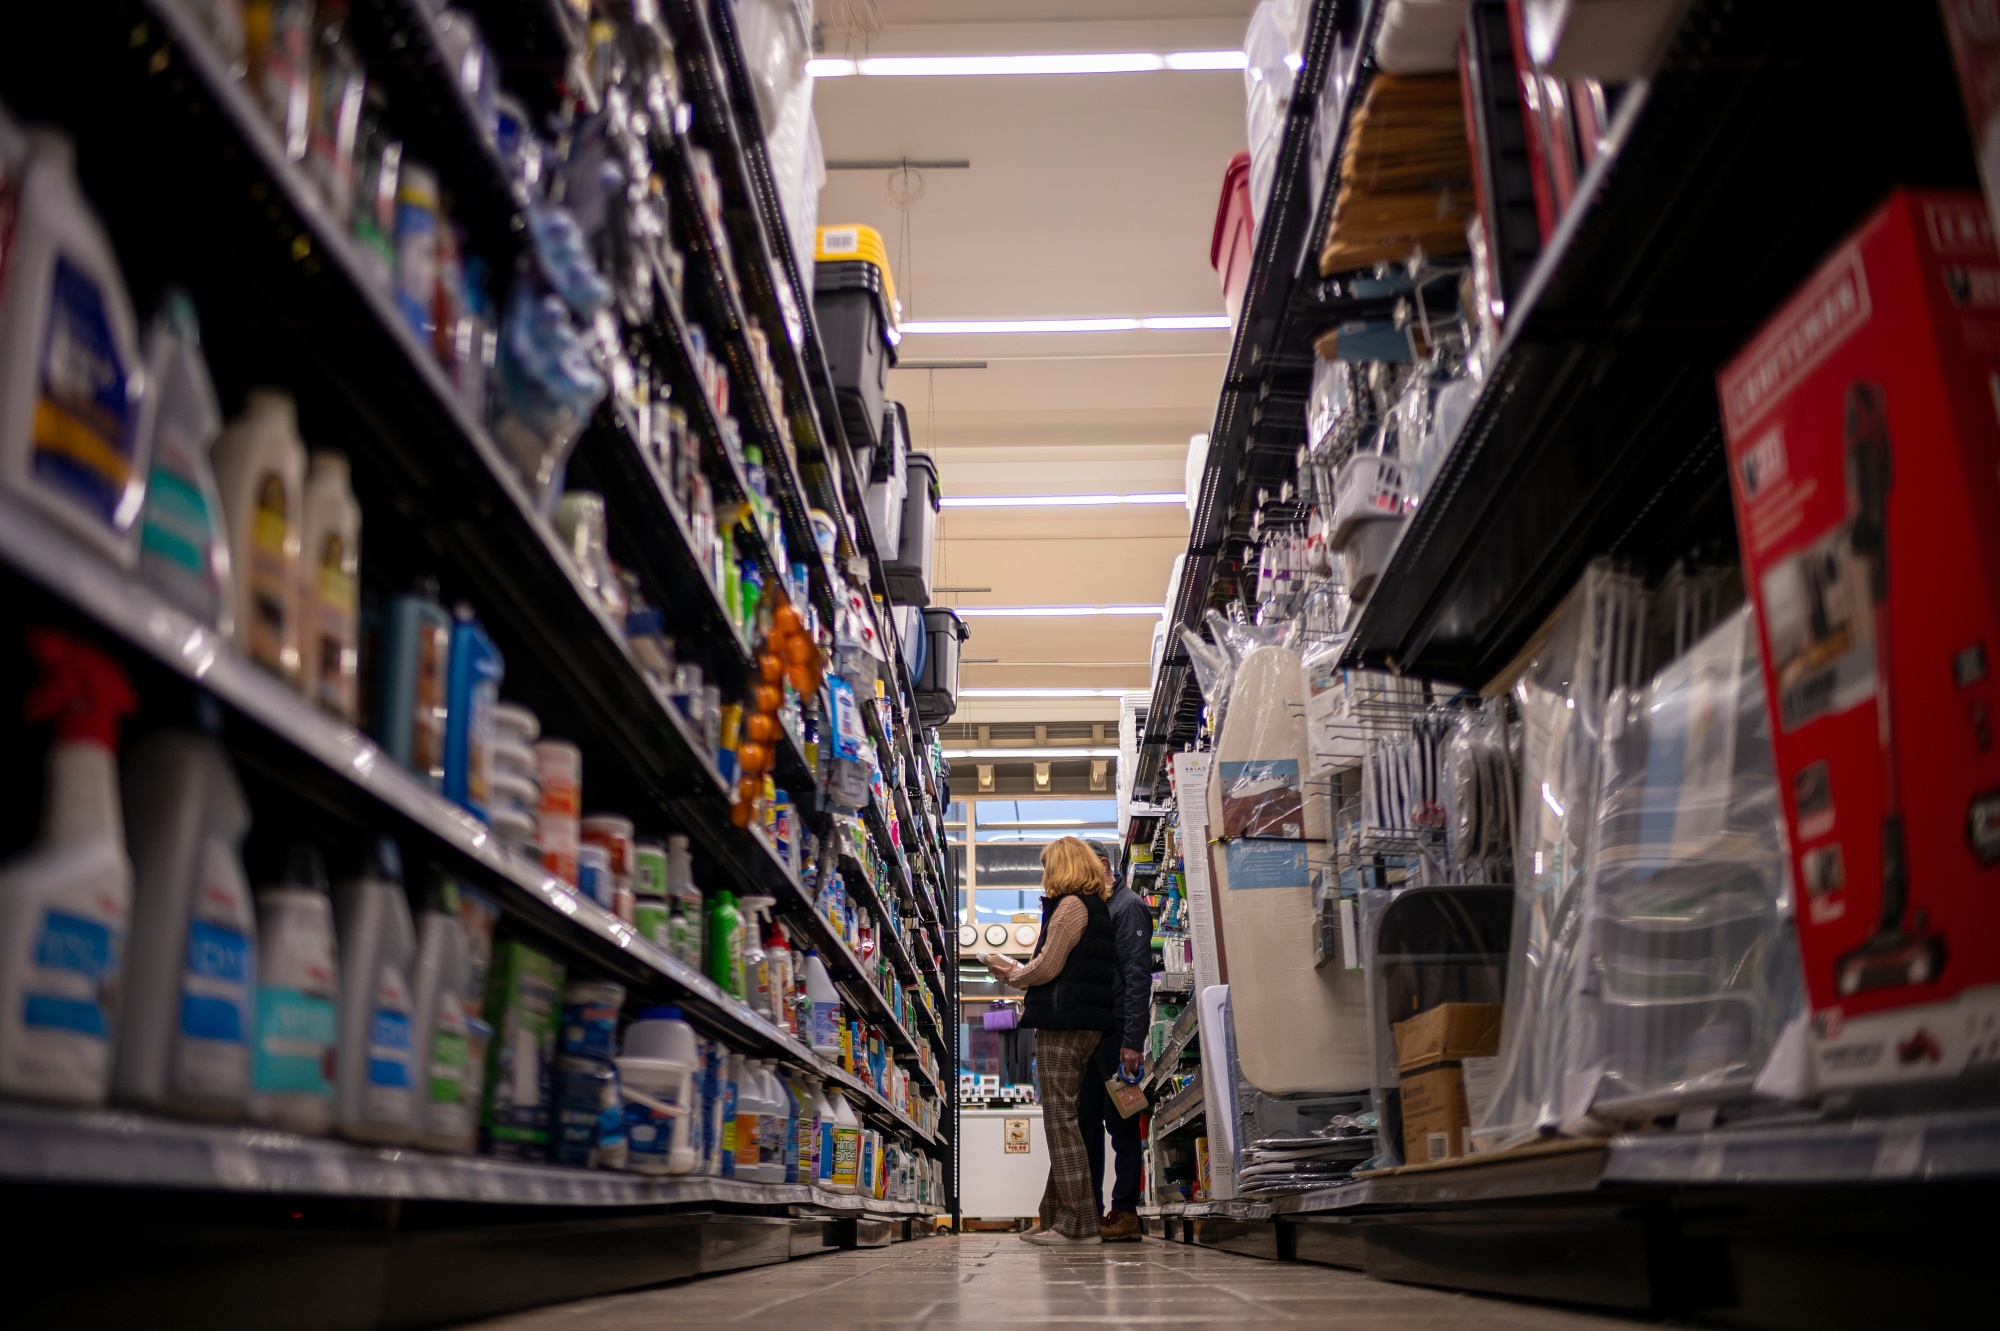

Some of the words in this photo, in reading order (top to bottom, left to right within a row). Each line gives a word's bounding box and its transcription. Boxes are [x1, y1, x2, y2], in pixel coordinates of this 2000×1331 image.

[1240, 845, 1269, 854] Ironing
[1269, 843, 1292, 852] Board
[836, 1136, 856, 1152] simp
[836, 1151, 856, 1164] gree
